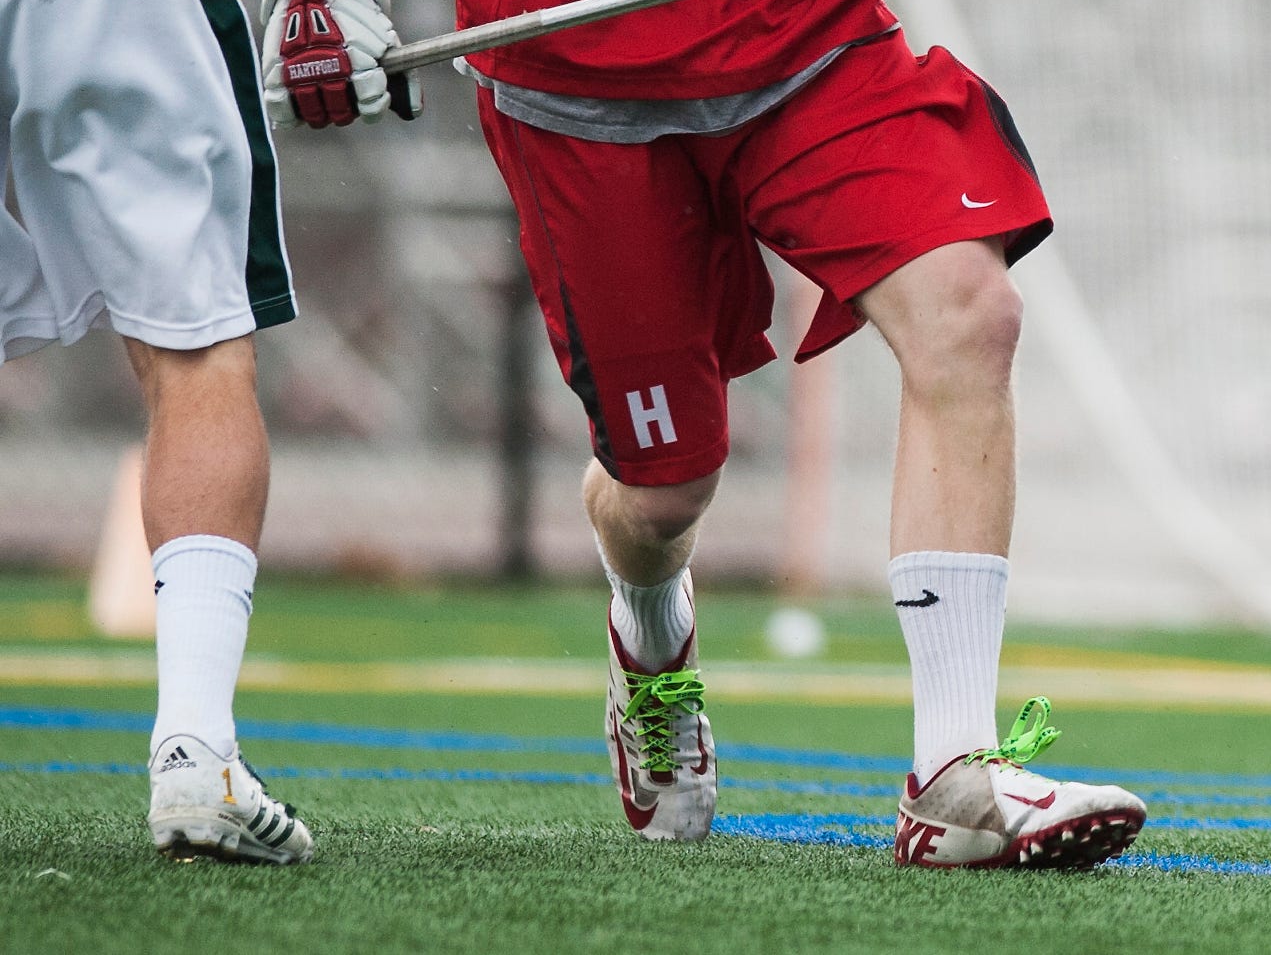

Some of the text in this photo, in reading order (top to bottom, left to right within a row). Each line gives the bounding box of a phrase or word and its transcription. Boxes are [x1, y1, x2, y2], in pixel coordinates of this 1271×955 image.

[287, 57, 341, 80] HARTFORD
[626, 384, 678, 449] H
[160, 760, 197, 773] adidas
[221, 767, 238, 806] 1
